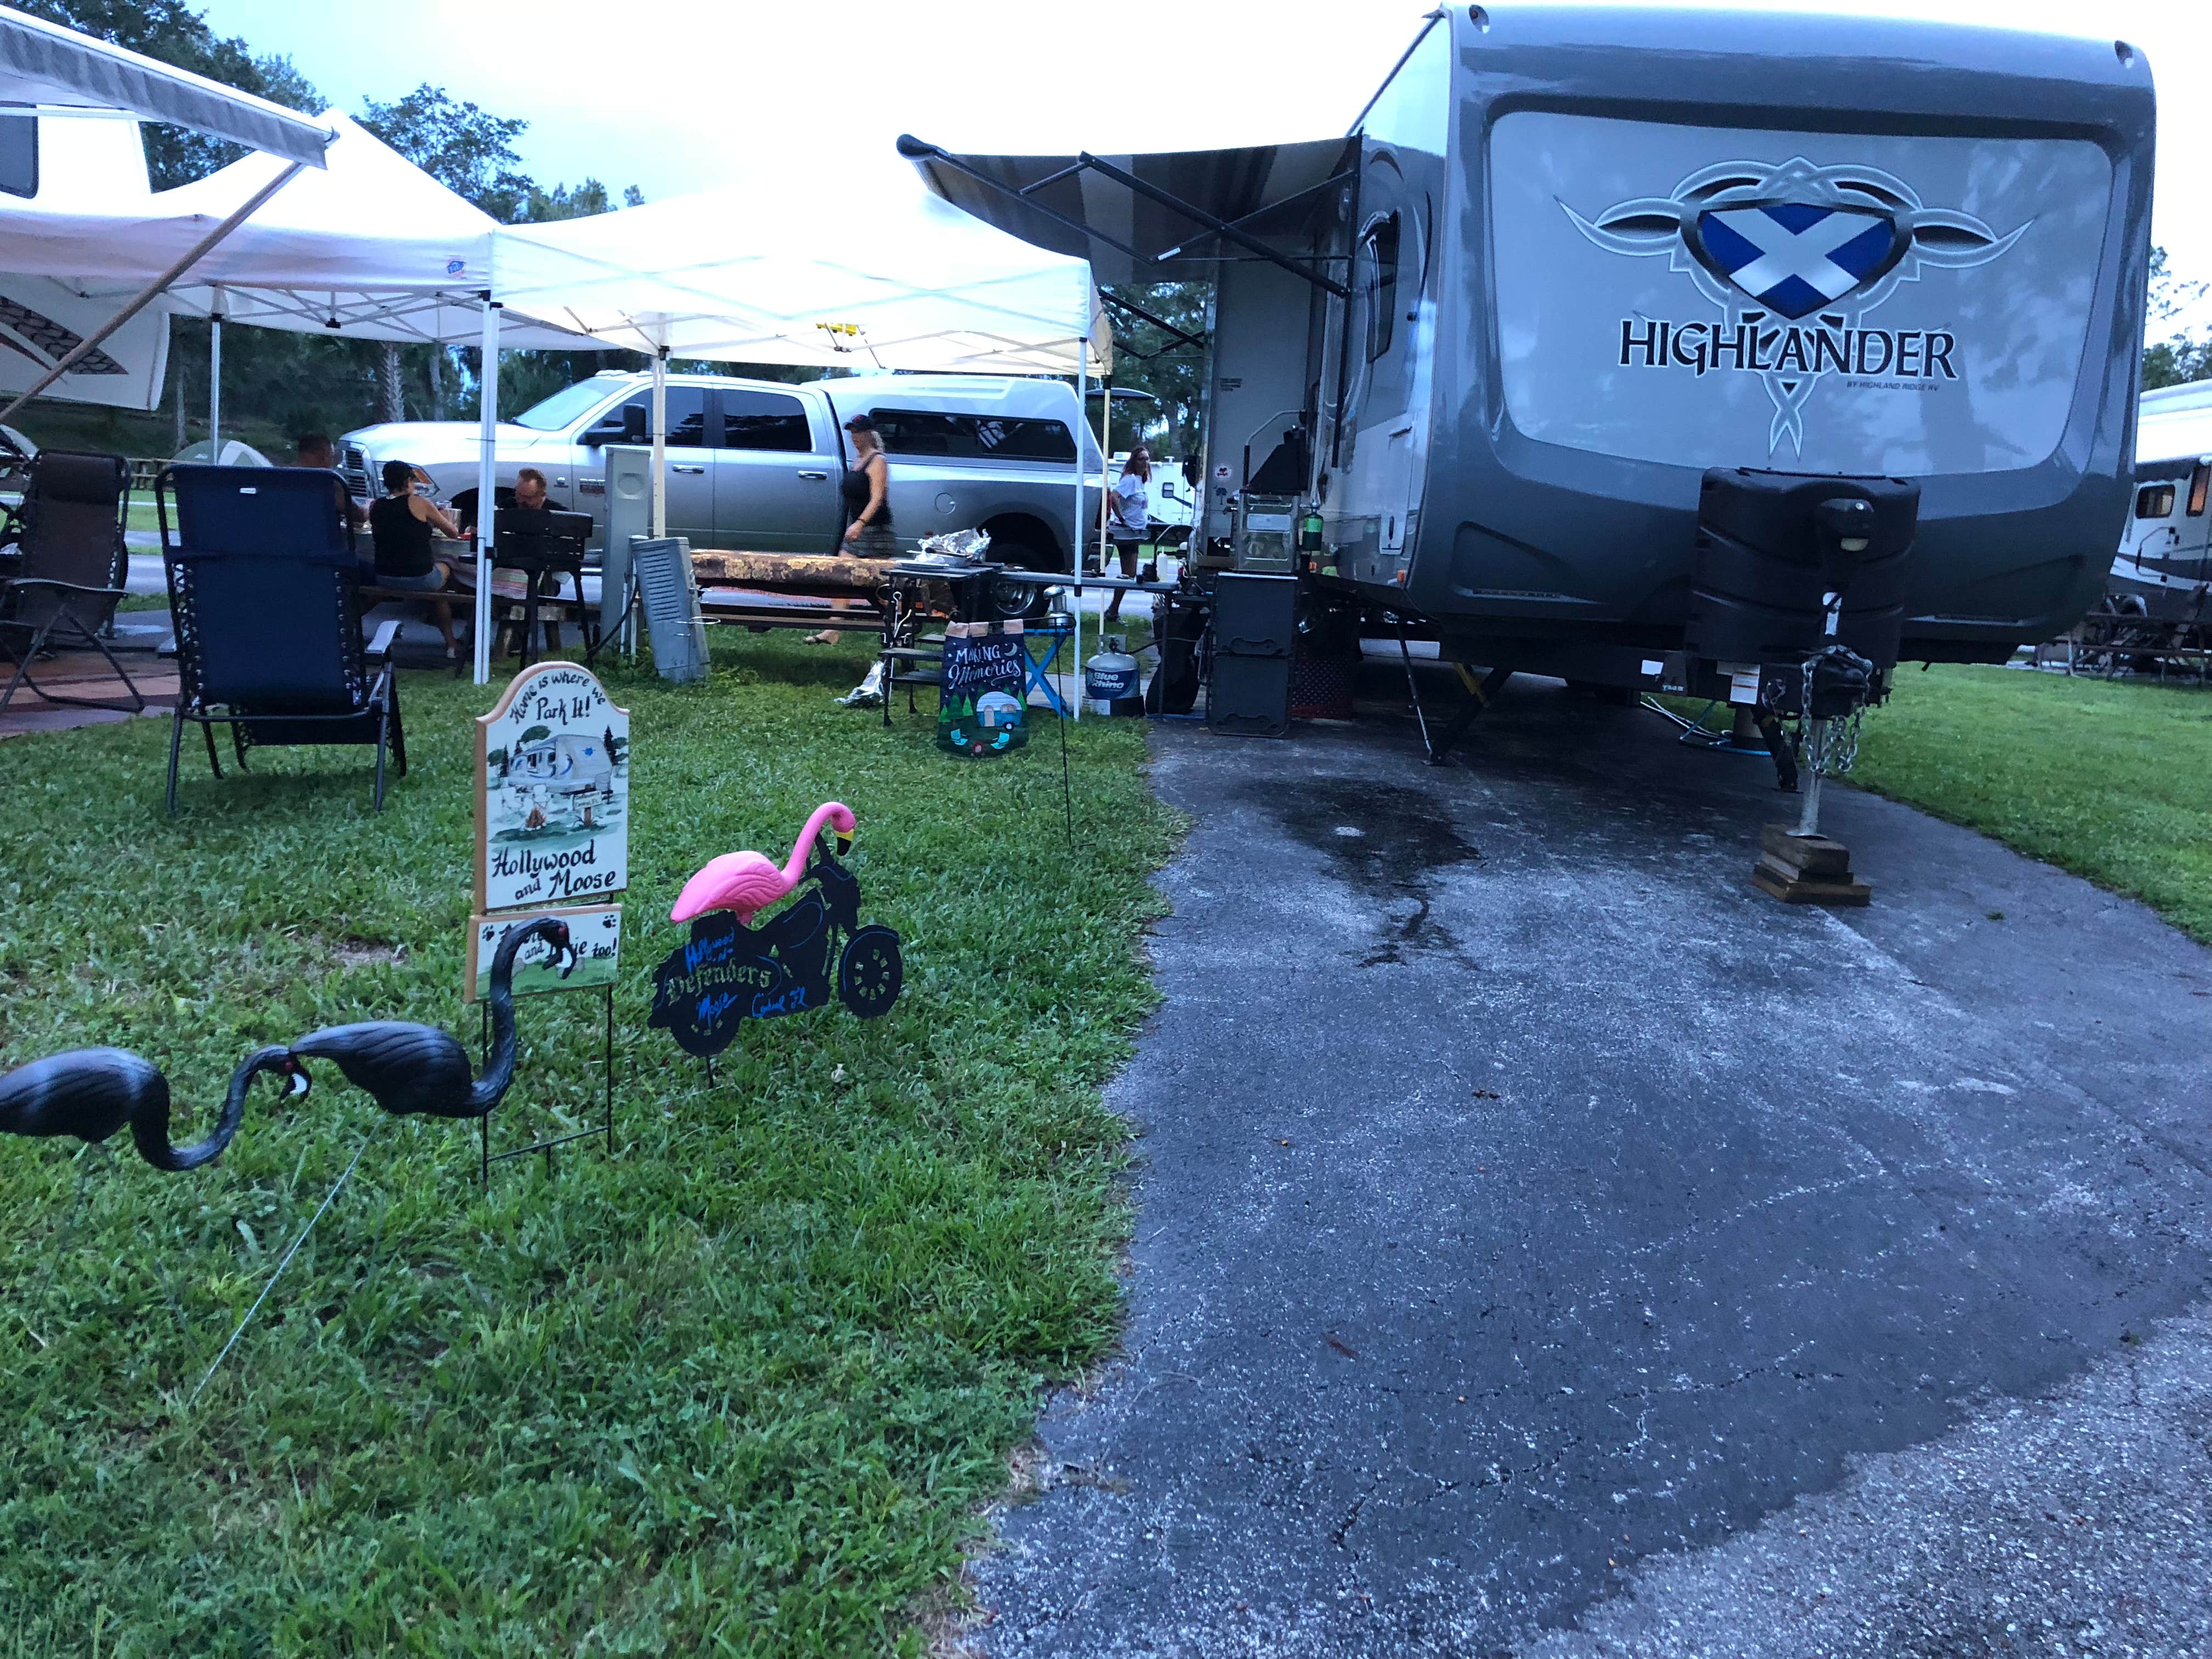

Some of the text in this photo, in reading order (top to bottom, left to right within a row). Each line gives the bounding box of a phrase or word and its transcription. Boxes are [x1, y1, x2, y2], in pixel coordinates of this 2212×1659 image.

[1619, 318, 1960, 380] HIGHLANDER
[1902, 382, 1925, 391] RIDGE
[955, 644, 1001, 663] MAKING
[948, 659, 1022, 690] Memories
[1092, 680, 1125, 689] Rhino
[1094, 672, 1119, 681] Blue
[510, 671, 606, 725] Home is where we
[536, 696, 590, 725] Park It!
[492, 839, 597, 878] Hollywood
[515, 868, 616, 900] and Moose
[524, 942, 545, 960] and
[591, 937, 618, 958] too!
